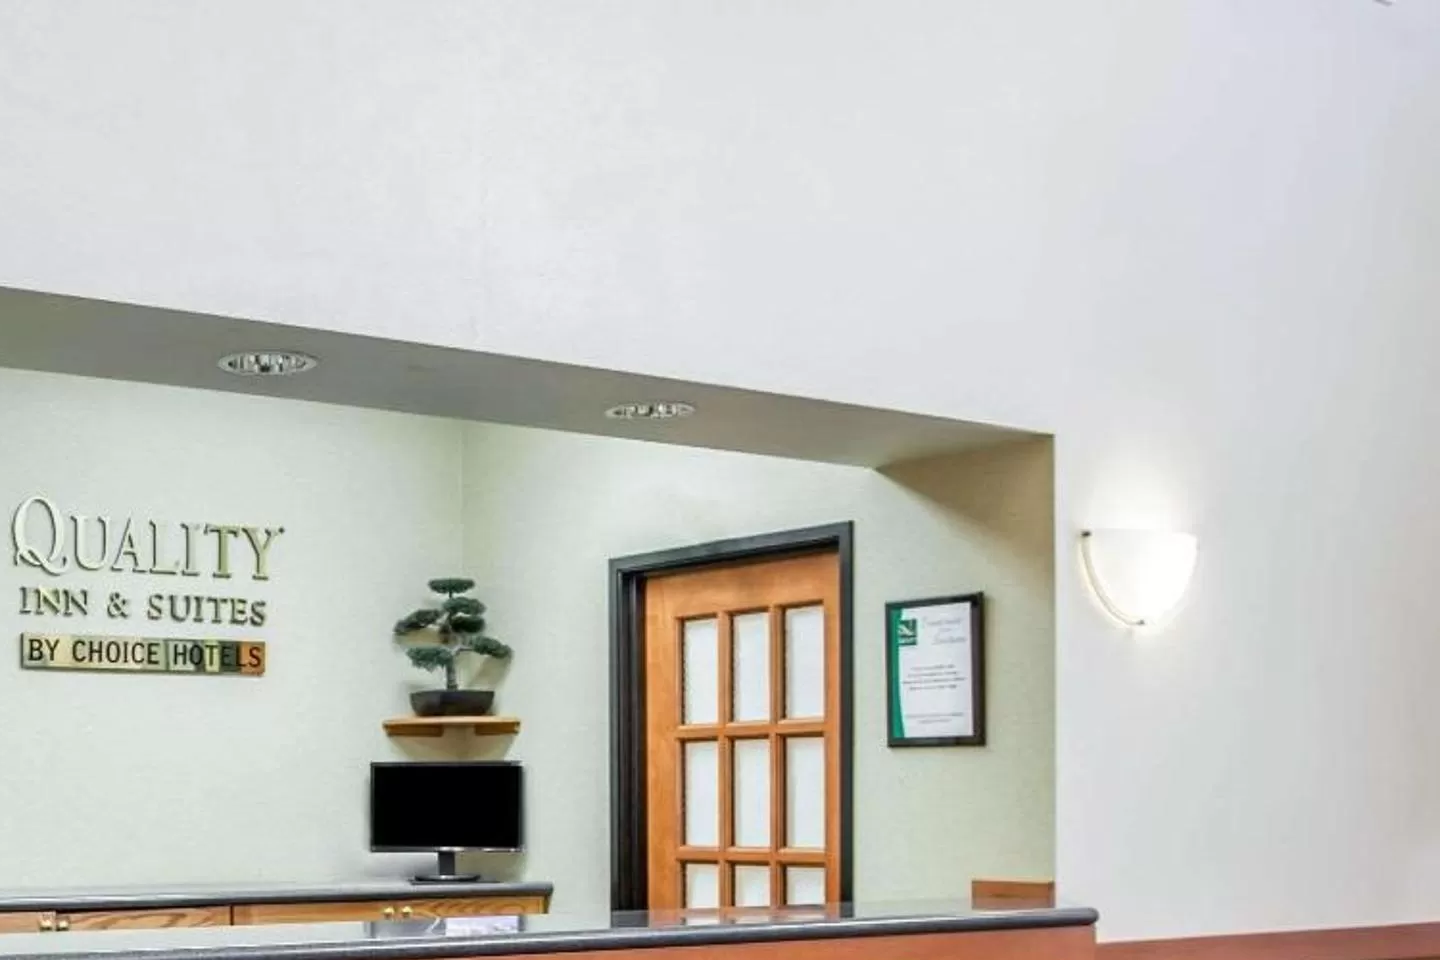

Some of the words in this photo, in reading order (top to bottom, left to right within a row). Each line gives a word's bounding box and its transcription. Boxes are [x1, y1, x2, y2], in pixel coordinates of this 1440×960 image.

[11, 496, 278, 581] QUALITY
[18, 586, 89, 616] INN
[106, 591, 131, 619] &
[146, 591, 267, 627] SUITES
[27, 637, 61, 662] BY
[70, 638, 161, 666] CHOICE
[172, 642, 262, 668] HOTELS
